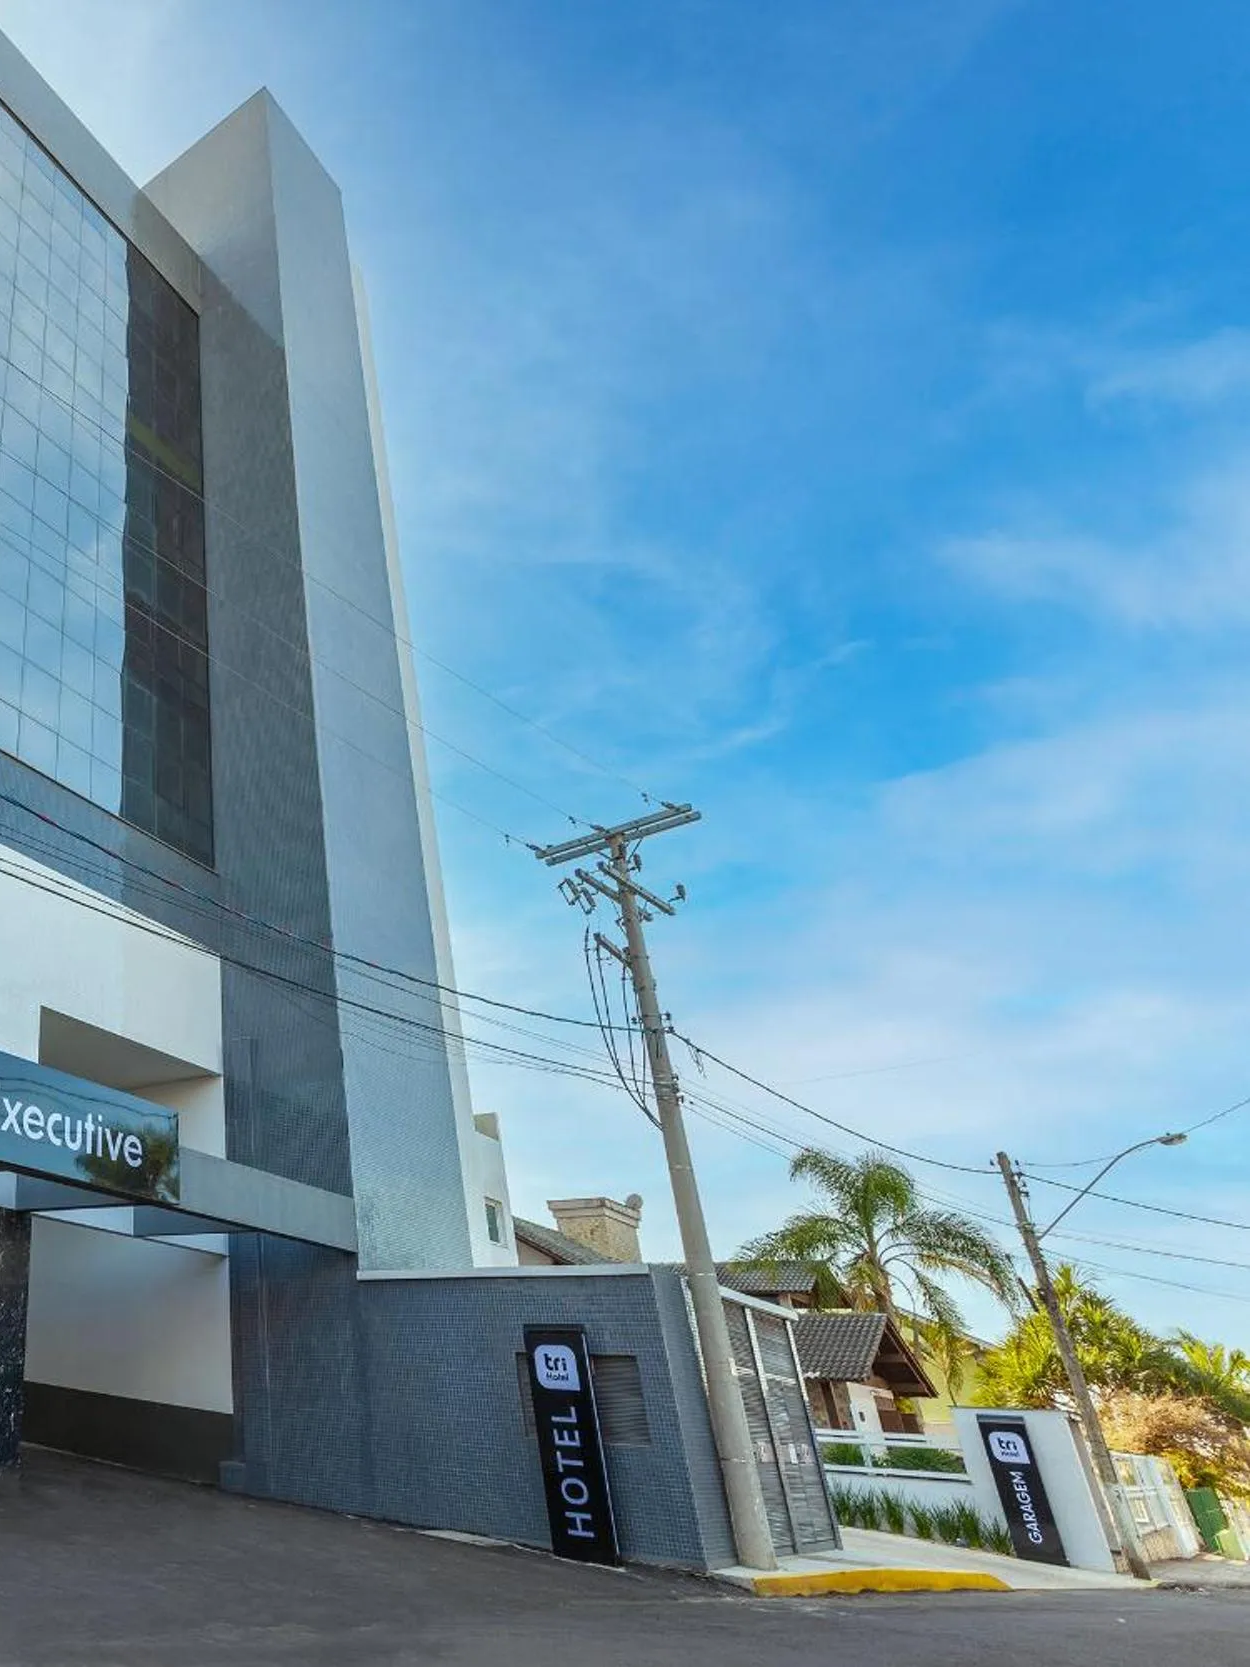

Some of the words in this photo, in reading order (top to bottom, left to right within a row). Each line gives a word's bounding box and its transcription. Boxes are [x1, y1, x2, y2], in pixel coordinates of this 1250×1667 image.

[543, 1353, 568, 1371] tri
[997, 1437, 1018, 1450] tri
[551, 1405, 595, 1539] HOTEL
[1010, 1470, 1043, 1544] GARAGEM
